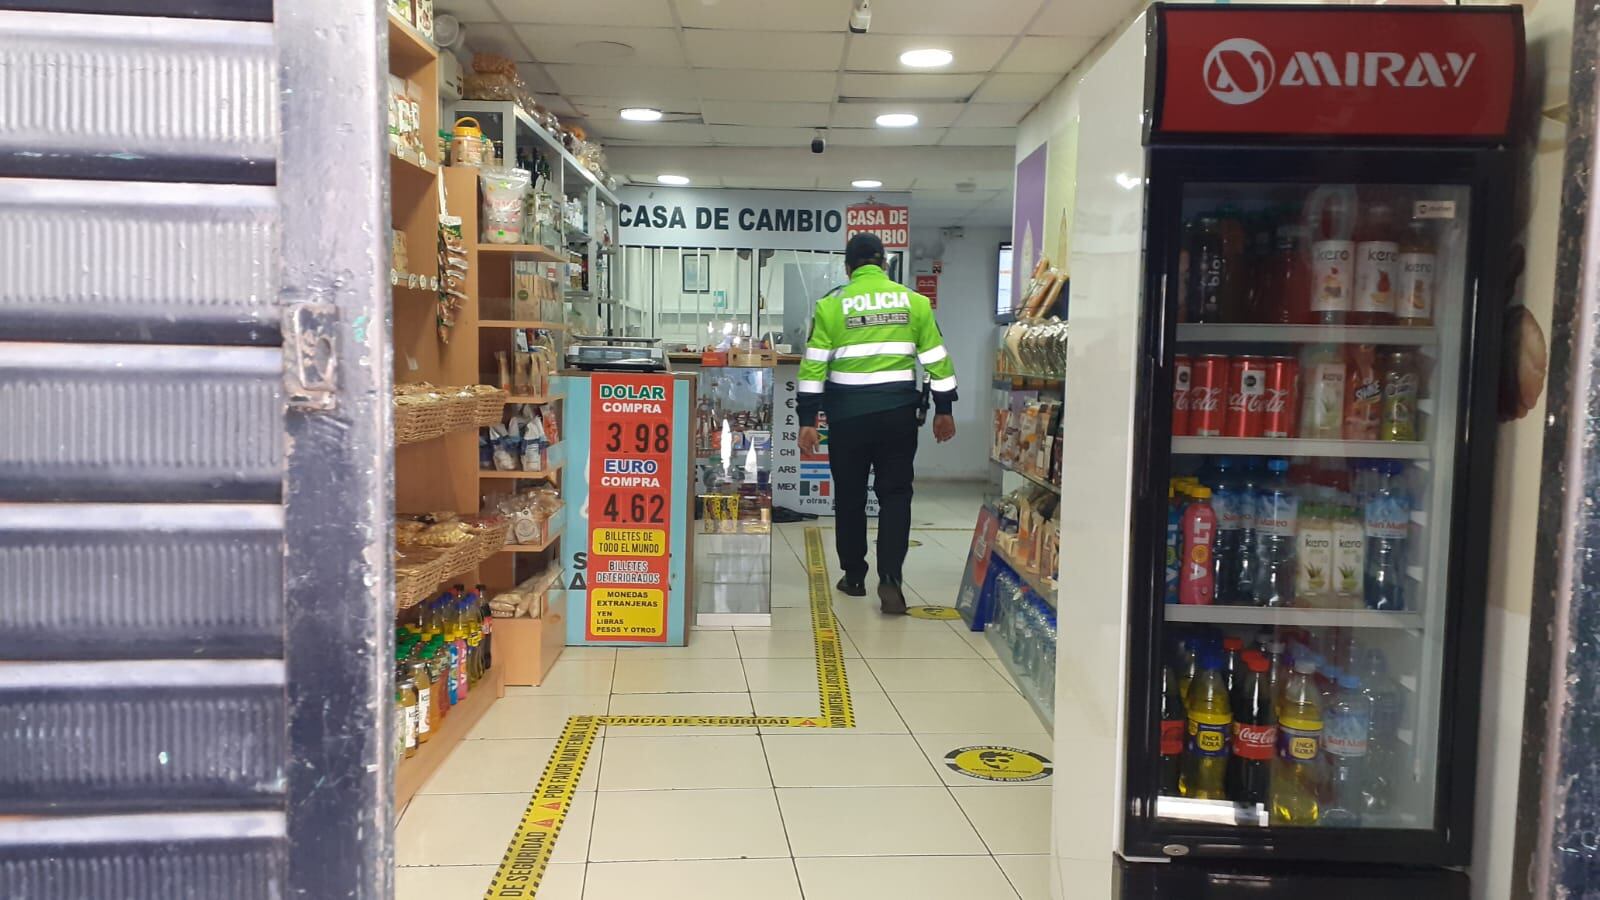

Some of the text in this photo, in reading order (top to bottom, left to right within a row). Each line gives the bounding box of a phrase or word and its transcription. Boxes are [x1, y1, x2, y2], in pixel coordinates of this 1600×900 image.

[1279, 51, 1477, 87] MIRAY
[619, 203, 842, 233] CASA DE CAMBIO
[847, 209, 907, 225] CASA DE
[841, 291, 912, 315] POLICIA
[600, 384, 666, 401] DOLAR
[602, 402, 662, 414] COMPRA
[785, 398, 794, 408] €
[785, 414, 794, 425] £
[782, 431, 797, 441] R$
[779, 448, 796, 456] CHI
[604, 459, 658, 474] EURO
[777, 465, 797, 474] ARS
[600, 476, 660, 488] COMPRA
[777, 482, 797, 490] MEX
[603, 493, 665, 524] 4.62
[605, 531, 653, 542] BILLETES DE
[598, 543, 660, 554] TODO EL MUNDO
[609, 561, 648, 572] BILLETES
[596, 572, 660, 584] DETERIORADOS
[607, 591, 649, 599] MONEDAS
[596, 600, 658, 608] EXTRANJERAS
[630, 626, 657, 634] OTROS
[697, 718, 790, 726] SEGURIDAD
[559, 731, 587, 762] MANTENGA
[550, 763, 575, 783] FAVOR
[543, 783, 566, 799] POR
[499, 831, 548, 898] DE SEGURIDAD
